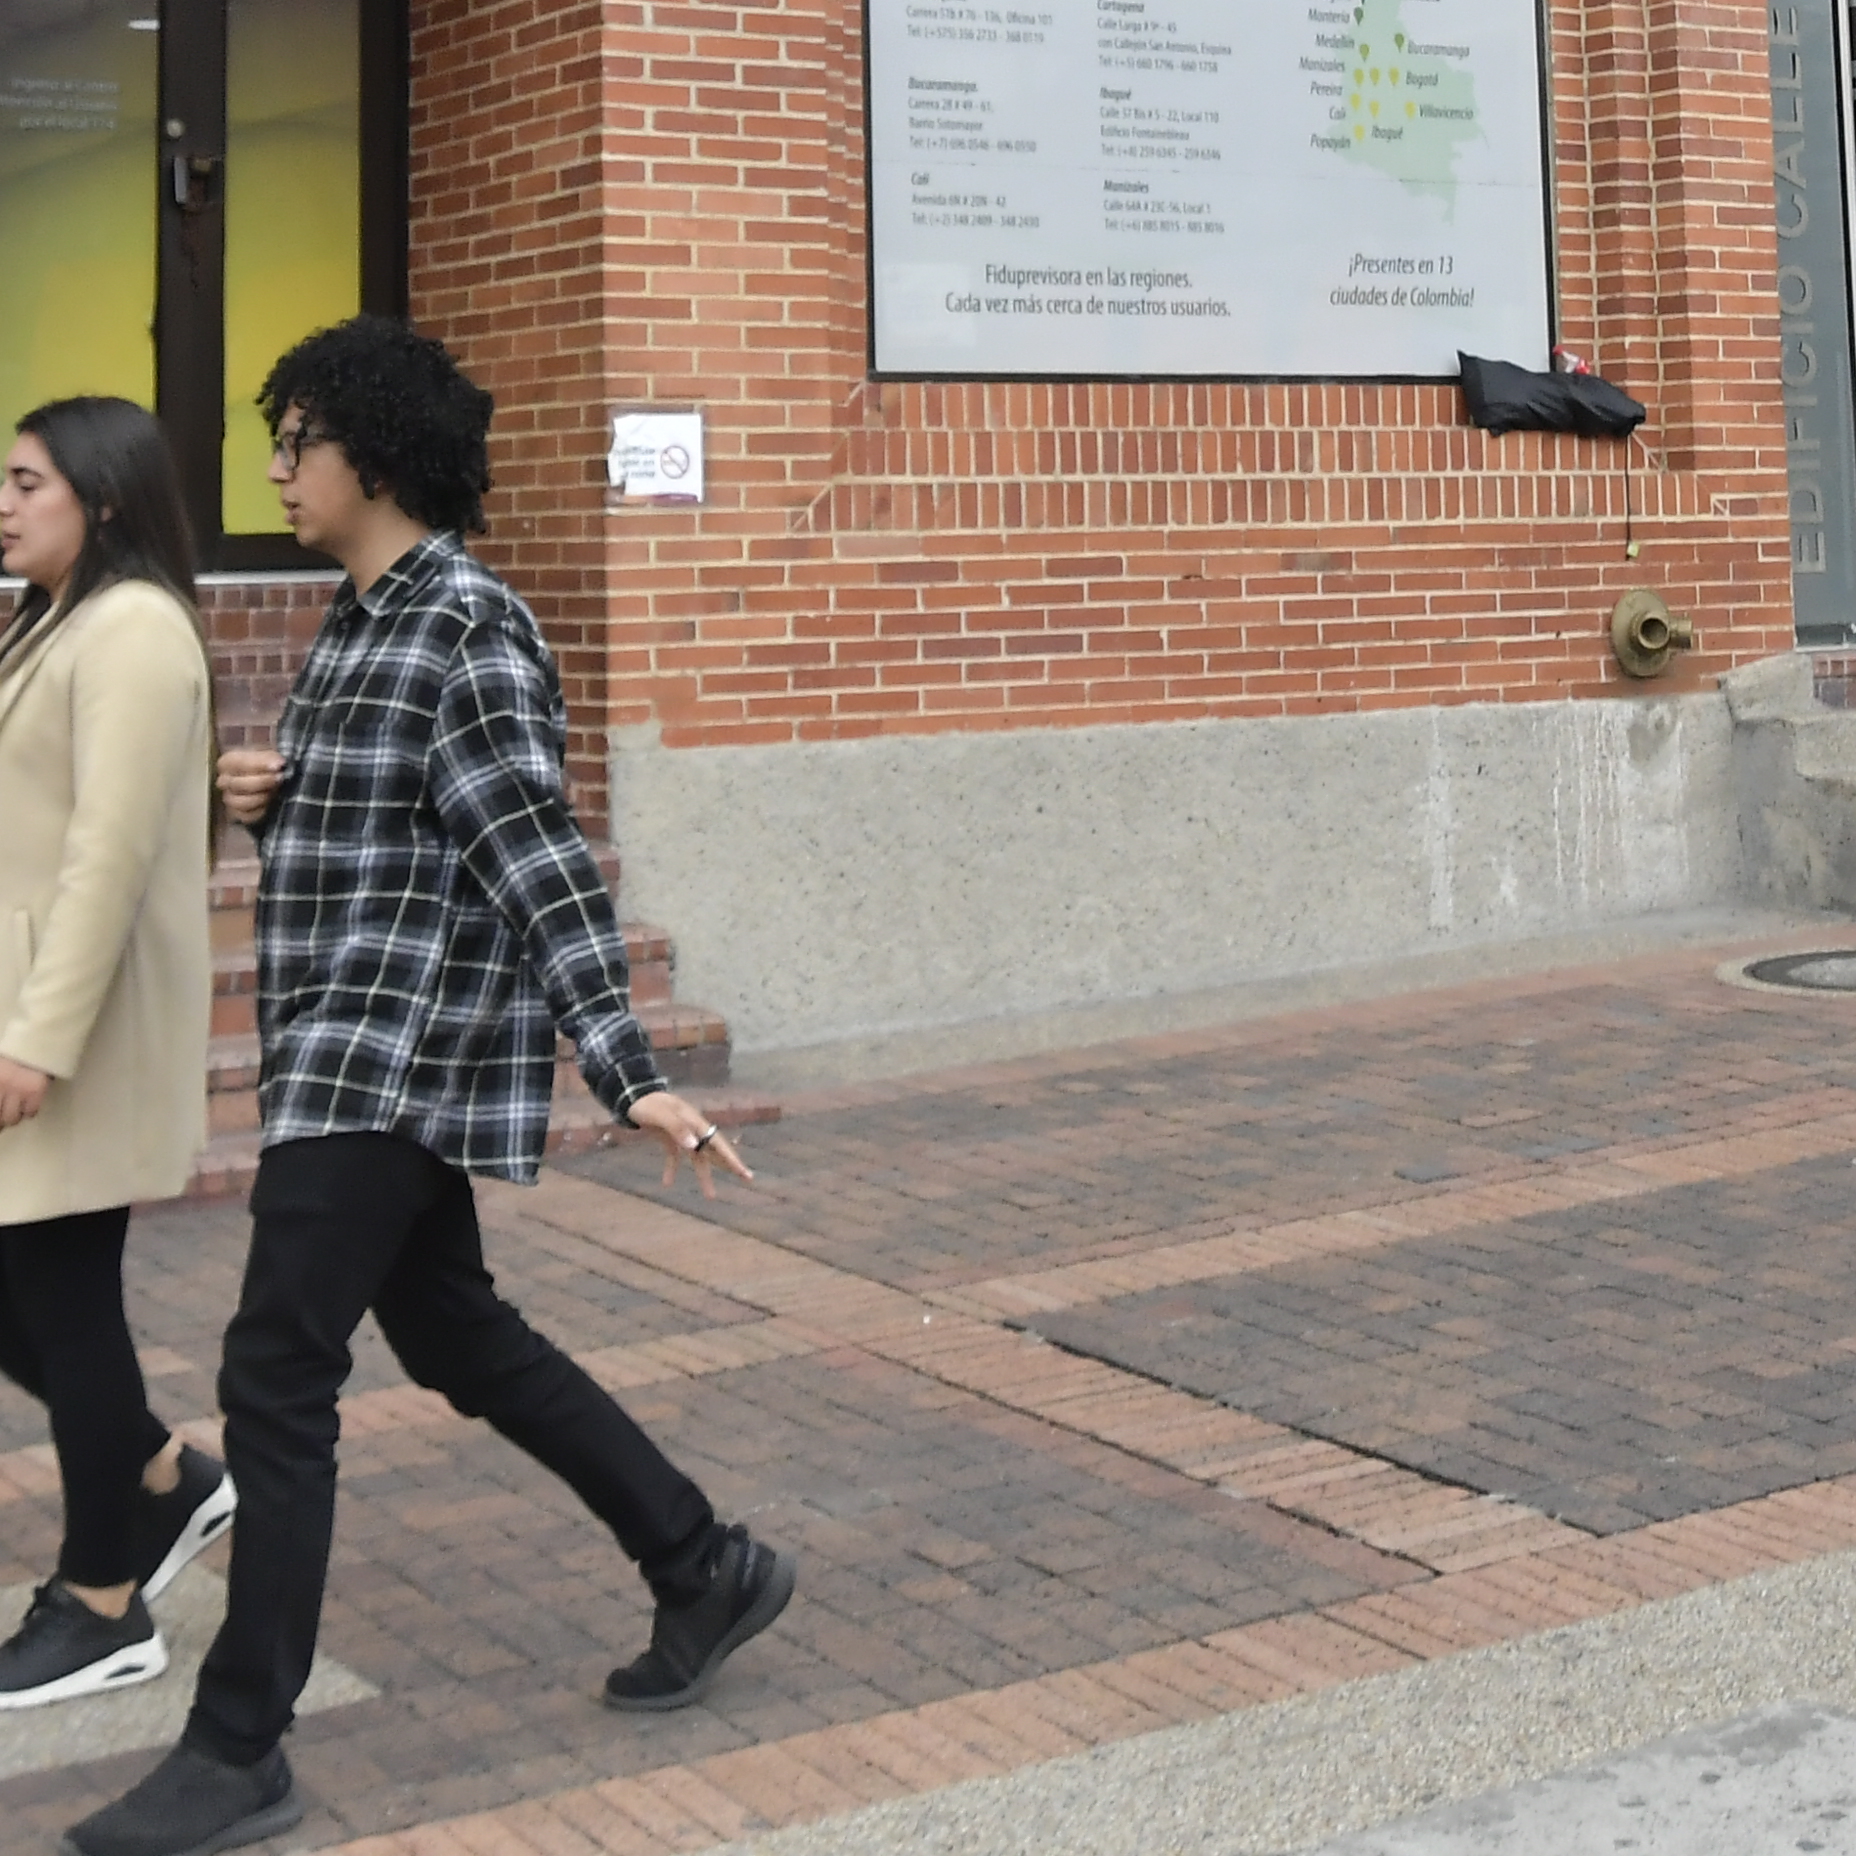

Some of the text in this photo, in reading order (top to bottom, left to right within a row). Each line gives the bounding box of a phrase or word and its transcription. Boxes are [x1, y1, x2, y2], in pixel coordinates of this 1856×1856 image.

[984, 262, 1193, 293] Fiduprevisora en las regiones.
[1347, 253, 1453, 278] ¡Presentes en 13
[944, 291, 1231, 318] Cada vez más cerca de nuestros usuarios.
[1329, 285, 1475, 308] ciudades de Colombia!
[1777, 263, 1827, 573] EDIFICIO
